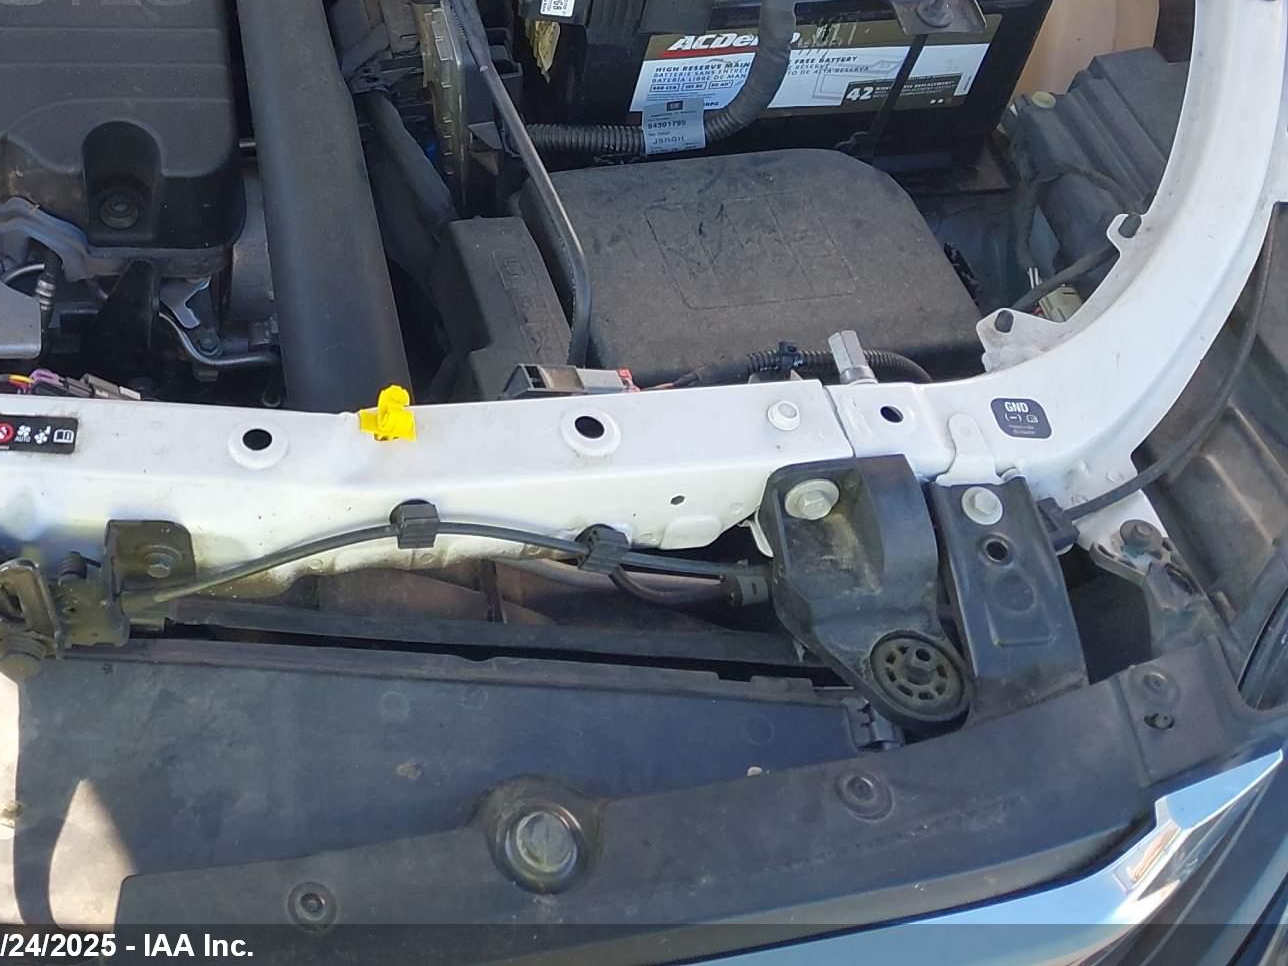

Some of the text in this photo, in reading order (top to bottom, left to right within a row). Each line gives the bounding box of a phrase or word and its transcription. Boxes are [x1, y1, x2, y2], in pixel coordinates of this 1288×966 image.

[794, 55, 858, 65] FREE BATTERY
[682, 63, 722, 72] RESERVE
[653, 70, 691, 78] BATTERIE
[846, 86, 874, 101] 42
[1004, 401, 1029, 413] GND
[14, 435, 31, 443] AUTO
